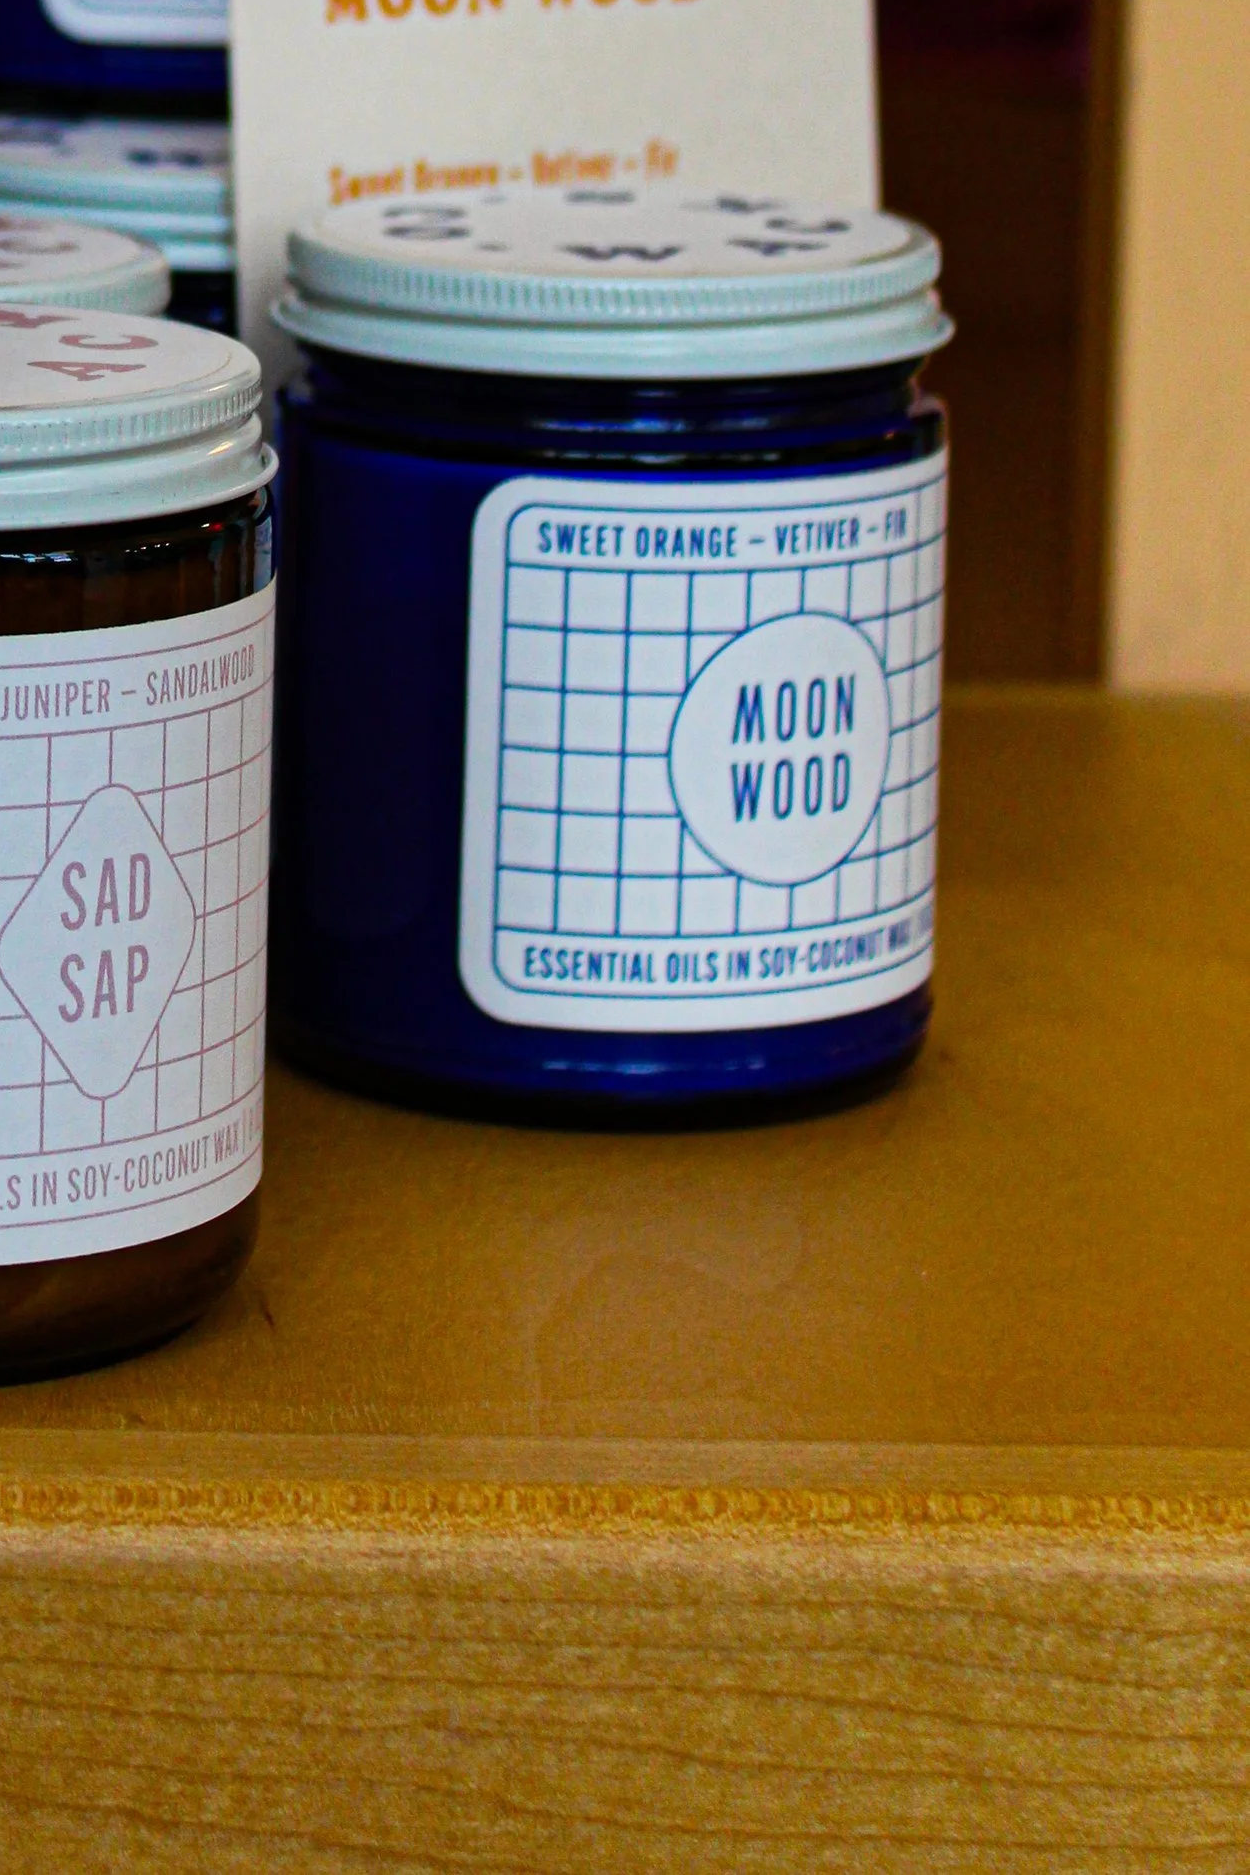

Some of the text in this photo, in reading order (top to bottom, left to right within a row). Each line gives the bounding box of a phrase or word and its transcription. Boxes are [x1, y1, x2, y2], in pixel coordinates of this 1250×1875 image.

[537, 519, 625, 557] SWEET
[635, 524, 739, 559] ORANGE
[774, 515, 861, 557] VETIVER
[884, 507, 908, 543] FIR
[0, 678, 112, 722] JUNIPER
[146, 642, 256, 708] SANDALWOOD
[730, 674, 856, 745] MOON
[730, 751, 853, 824] WOOD
[60, 851, 152, 931] SAD
[58, 943, 150, 1023] SAP
[523, 944, 657, 986] ESSENTIAL
[665, 943, 720, 984] OILS
[726, 939, 751, 978] IN
[758, 922, 886, 981] SOY-COCONUT
[31, 1170, 58, 1207] IN
[67, 1136, 210, 1205] SOY-COCONUT
[214, 1117, 240, 1165] WAX
